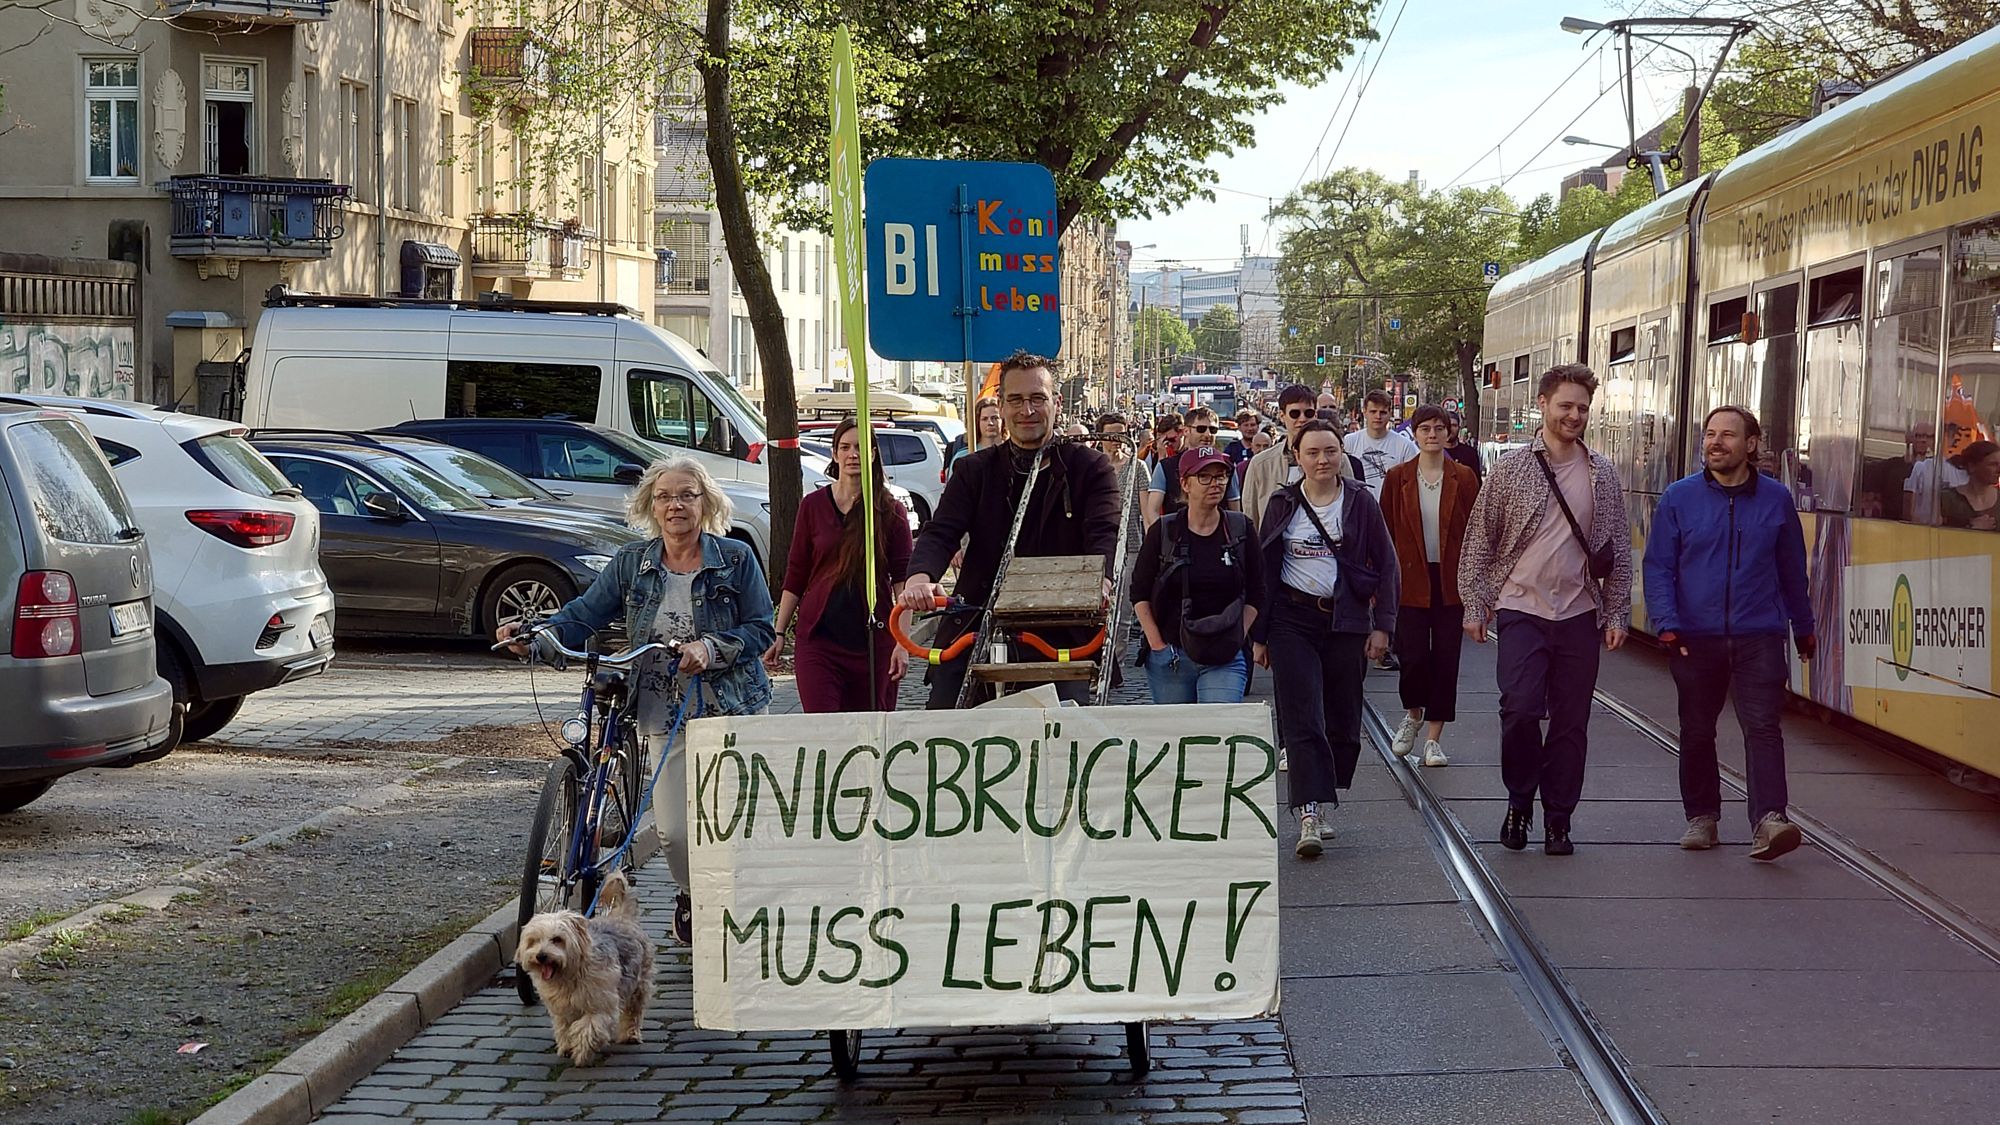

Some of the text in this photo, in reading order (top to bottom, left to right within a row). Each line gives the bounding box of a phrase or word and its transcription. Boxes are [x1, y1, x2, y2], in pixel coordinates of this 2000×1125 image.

[977, 199, 1055, 237] Köni
[1738, 125, 1983, 264] Die Berufsausbildung bei der DVB AG
[884, 222, 940, 297] BI
[979, 251, 1055, 273] muss
[1487, 263, 1497, 276] S
[1199, 446, 1214, 457] N
[694, 722, 1278, 846] KÖNIGSBRÜCKER
[722, 905, 910, 988] MUSS
